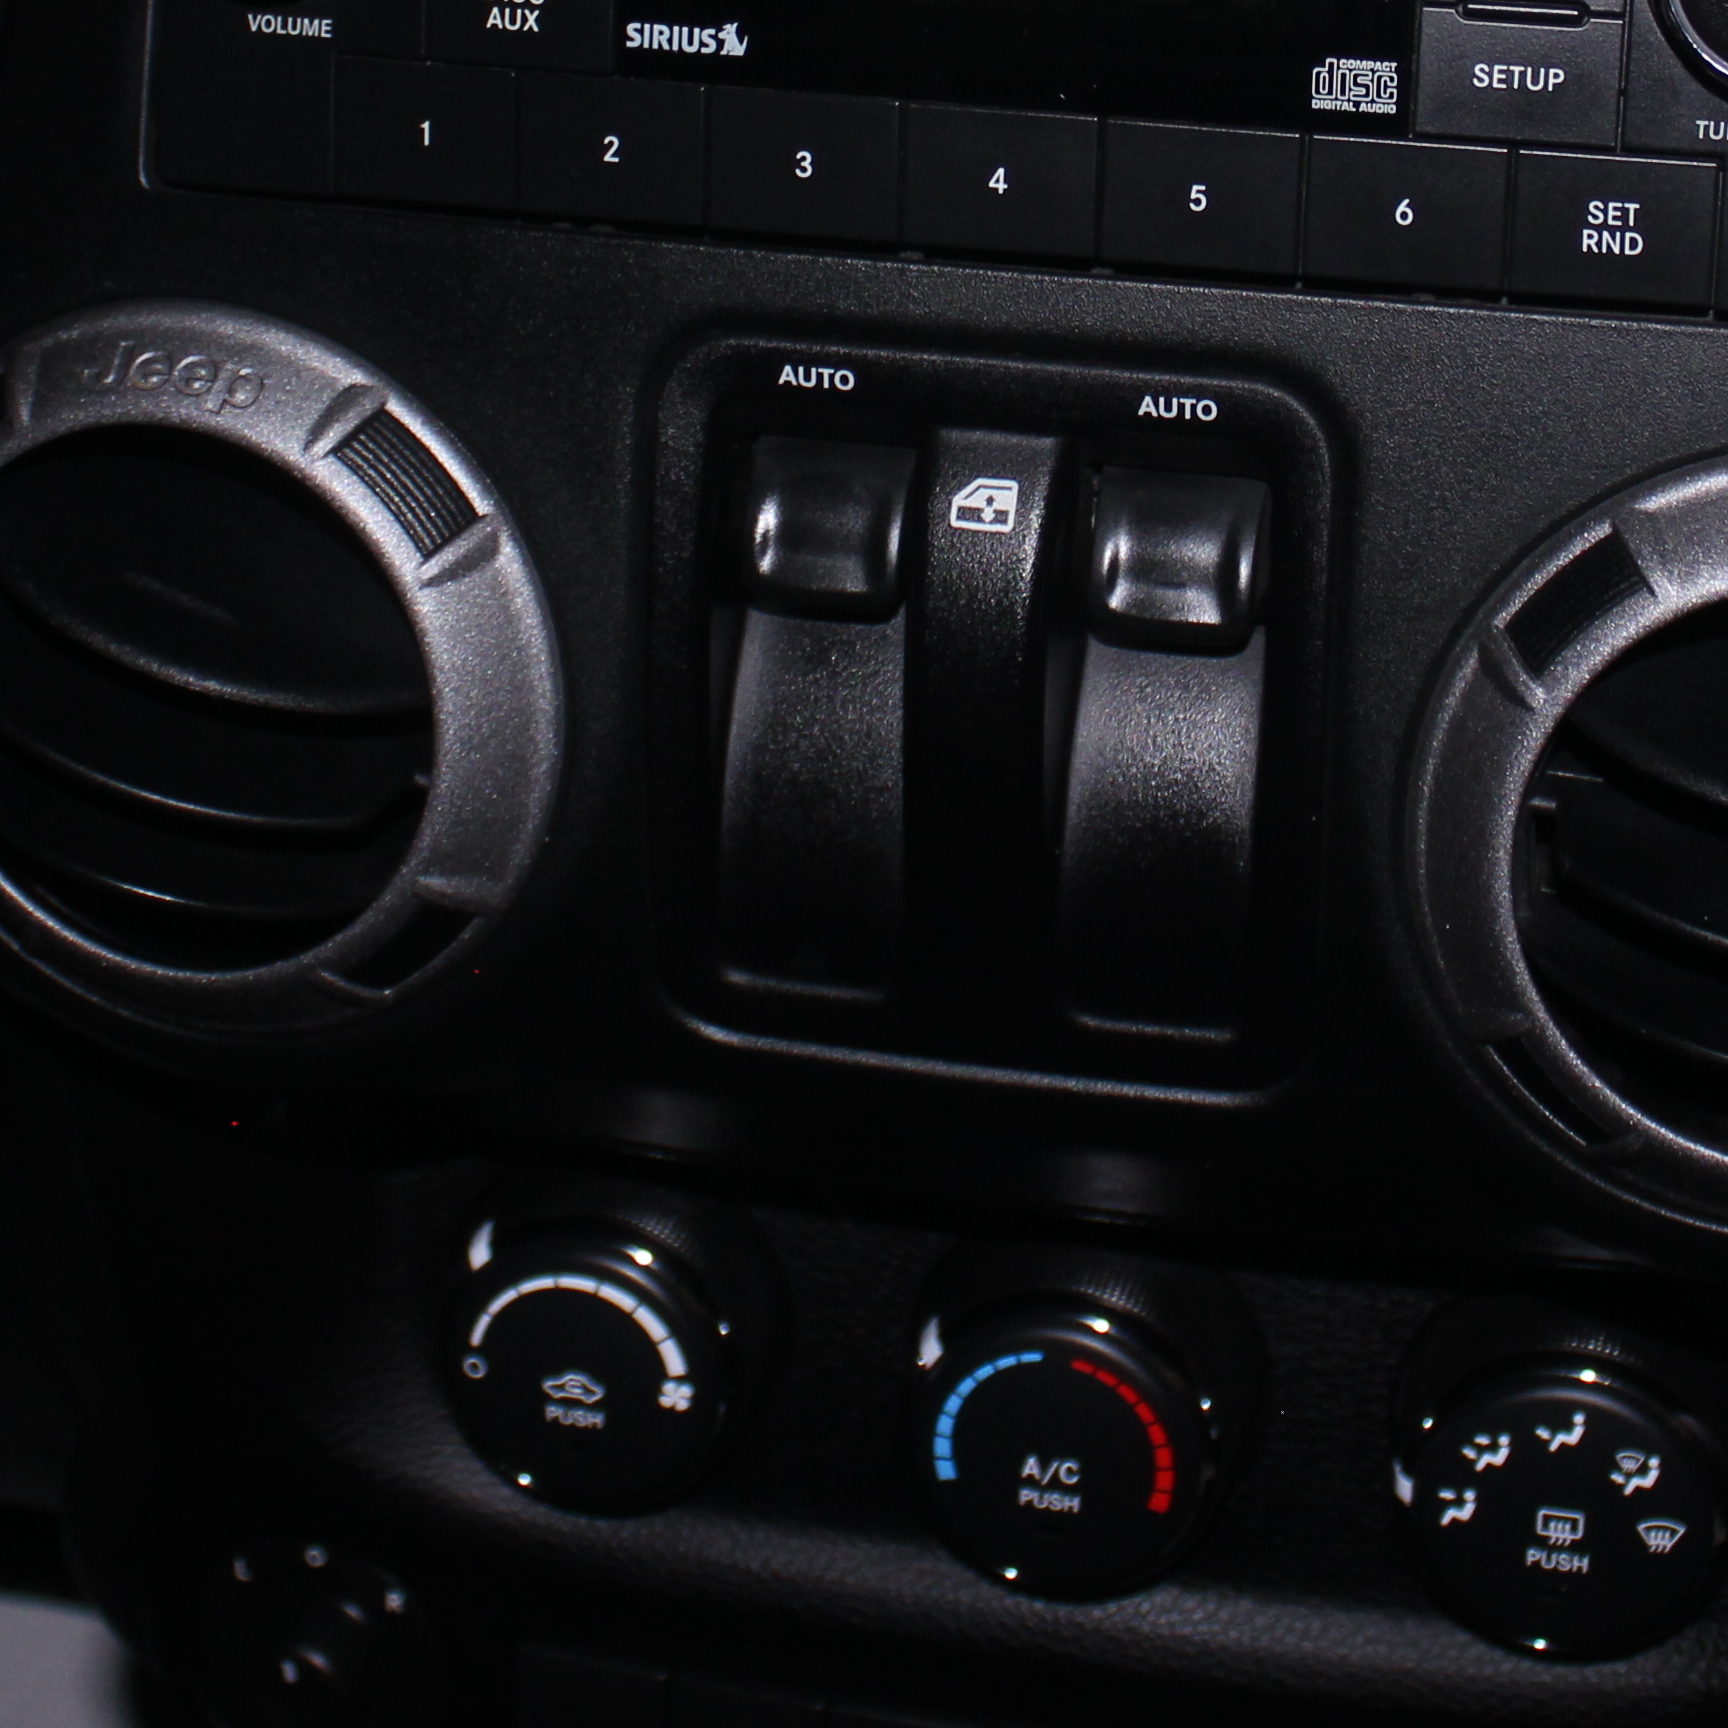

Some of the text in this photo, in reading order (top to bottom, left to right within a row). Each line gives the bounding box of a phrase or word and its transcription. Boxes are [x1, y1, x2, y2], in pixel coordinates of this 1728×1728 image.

[247, 13, 334, 39] VOLUME
[486, 7, 541, 33] AUX
[626, 22, 718, 55] SIRIUS
[1339, 58, 1398, 72] COMPACT
[1472, 63, 1566, 93] SETUP
[1311, 99, 1397, 114] DIGITAL AUDIO
[420, 120, 431, 147] 1
[603, 135, 621, 164] 2
[795, 150, 814, 179] 3
[988, 167, 1009, 196] 4
[1189, 184, 1208, 213] 5
[1395, 198, 1415, 227] 6
[1587, 200, 1641, 228] SET
[1582, 229, 1645, 257] RND
[82, 339, 265, 415] Jeep
[778, 364, 856, 392] AUTO
[1137, 395, 1219, 422] AUTO
[544, 1402, 606, 1430] PUSH
[1022, 1455, 1081, 1486] A/C
[1019, 1489, 1082, 1514] PUSH
[1526, 1546, 1591, 1575] PUSH
